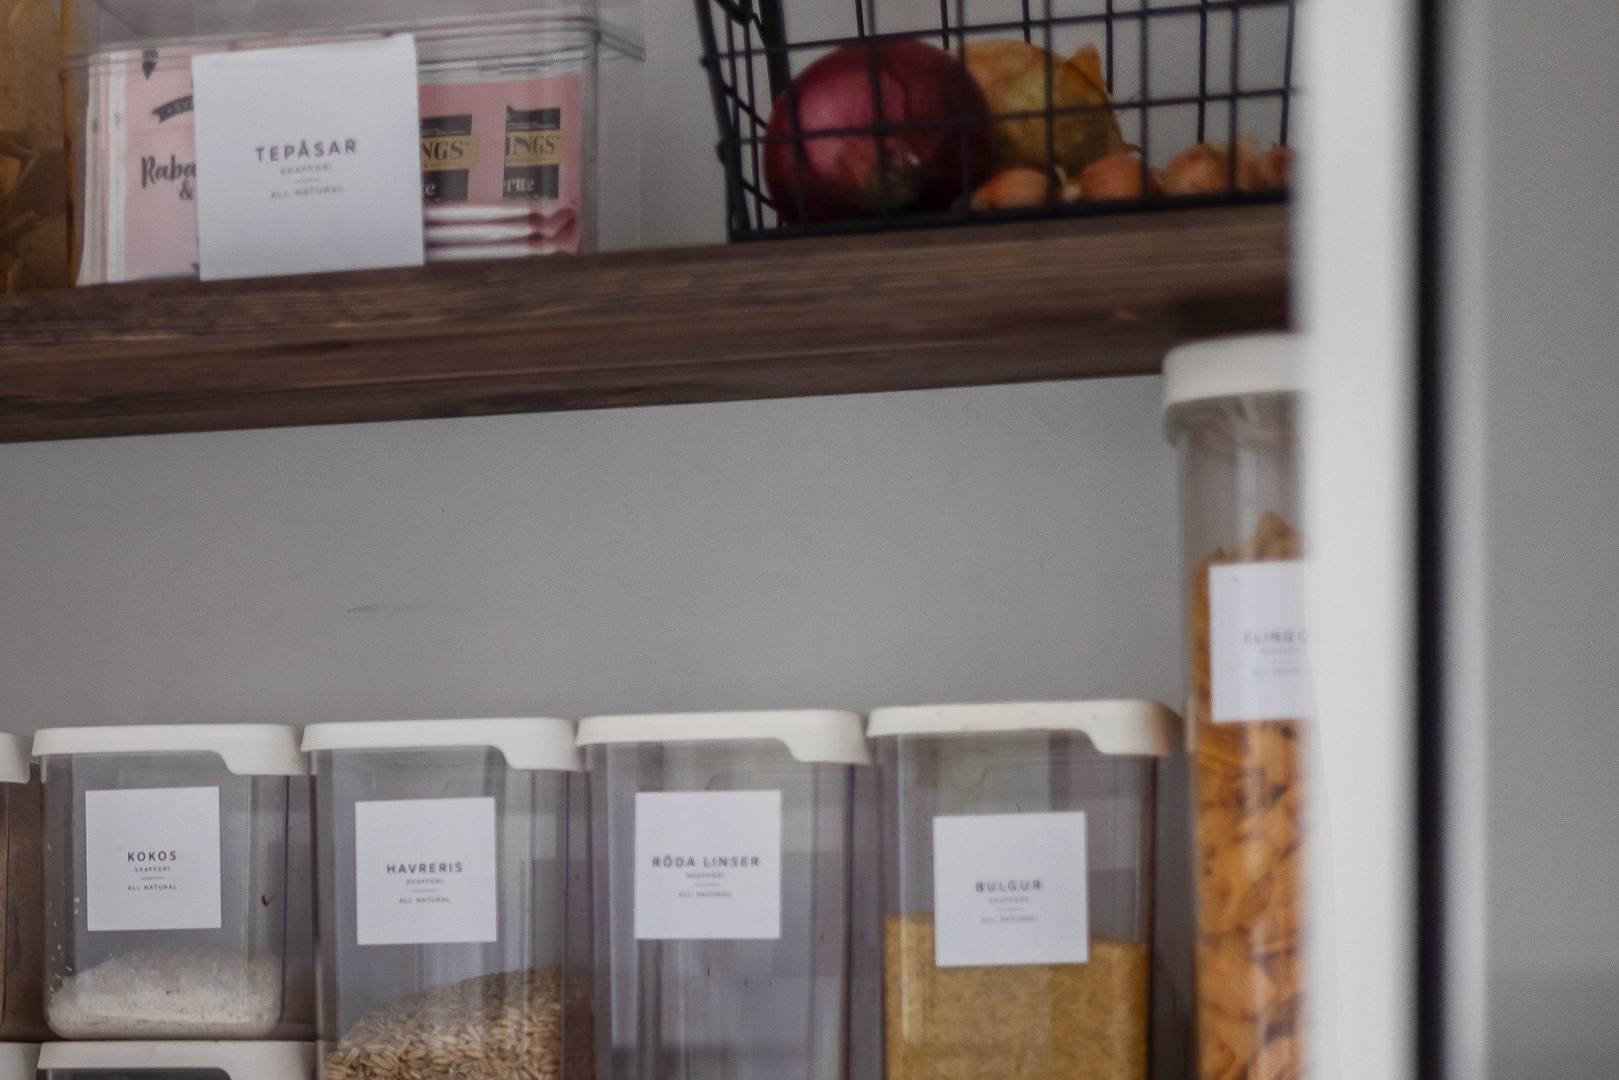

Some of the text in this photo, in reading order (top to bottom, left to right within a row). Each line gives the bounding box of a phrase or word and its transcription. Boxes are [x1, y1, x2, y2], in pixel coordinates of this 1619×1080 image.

[255, 138, 356, 162] TEPÅSAR
[127, 850, 177, 862] KOKOS
[703, 856, 761, 868] LINSER
[386, 862, 463, 874] HAVRERIS
[975, 880, 1043, 893] BULGUR
